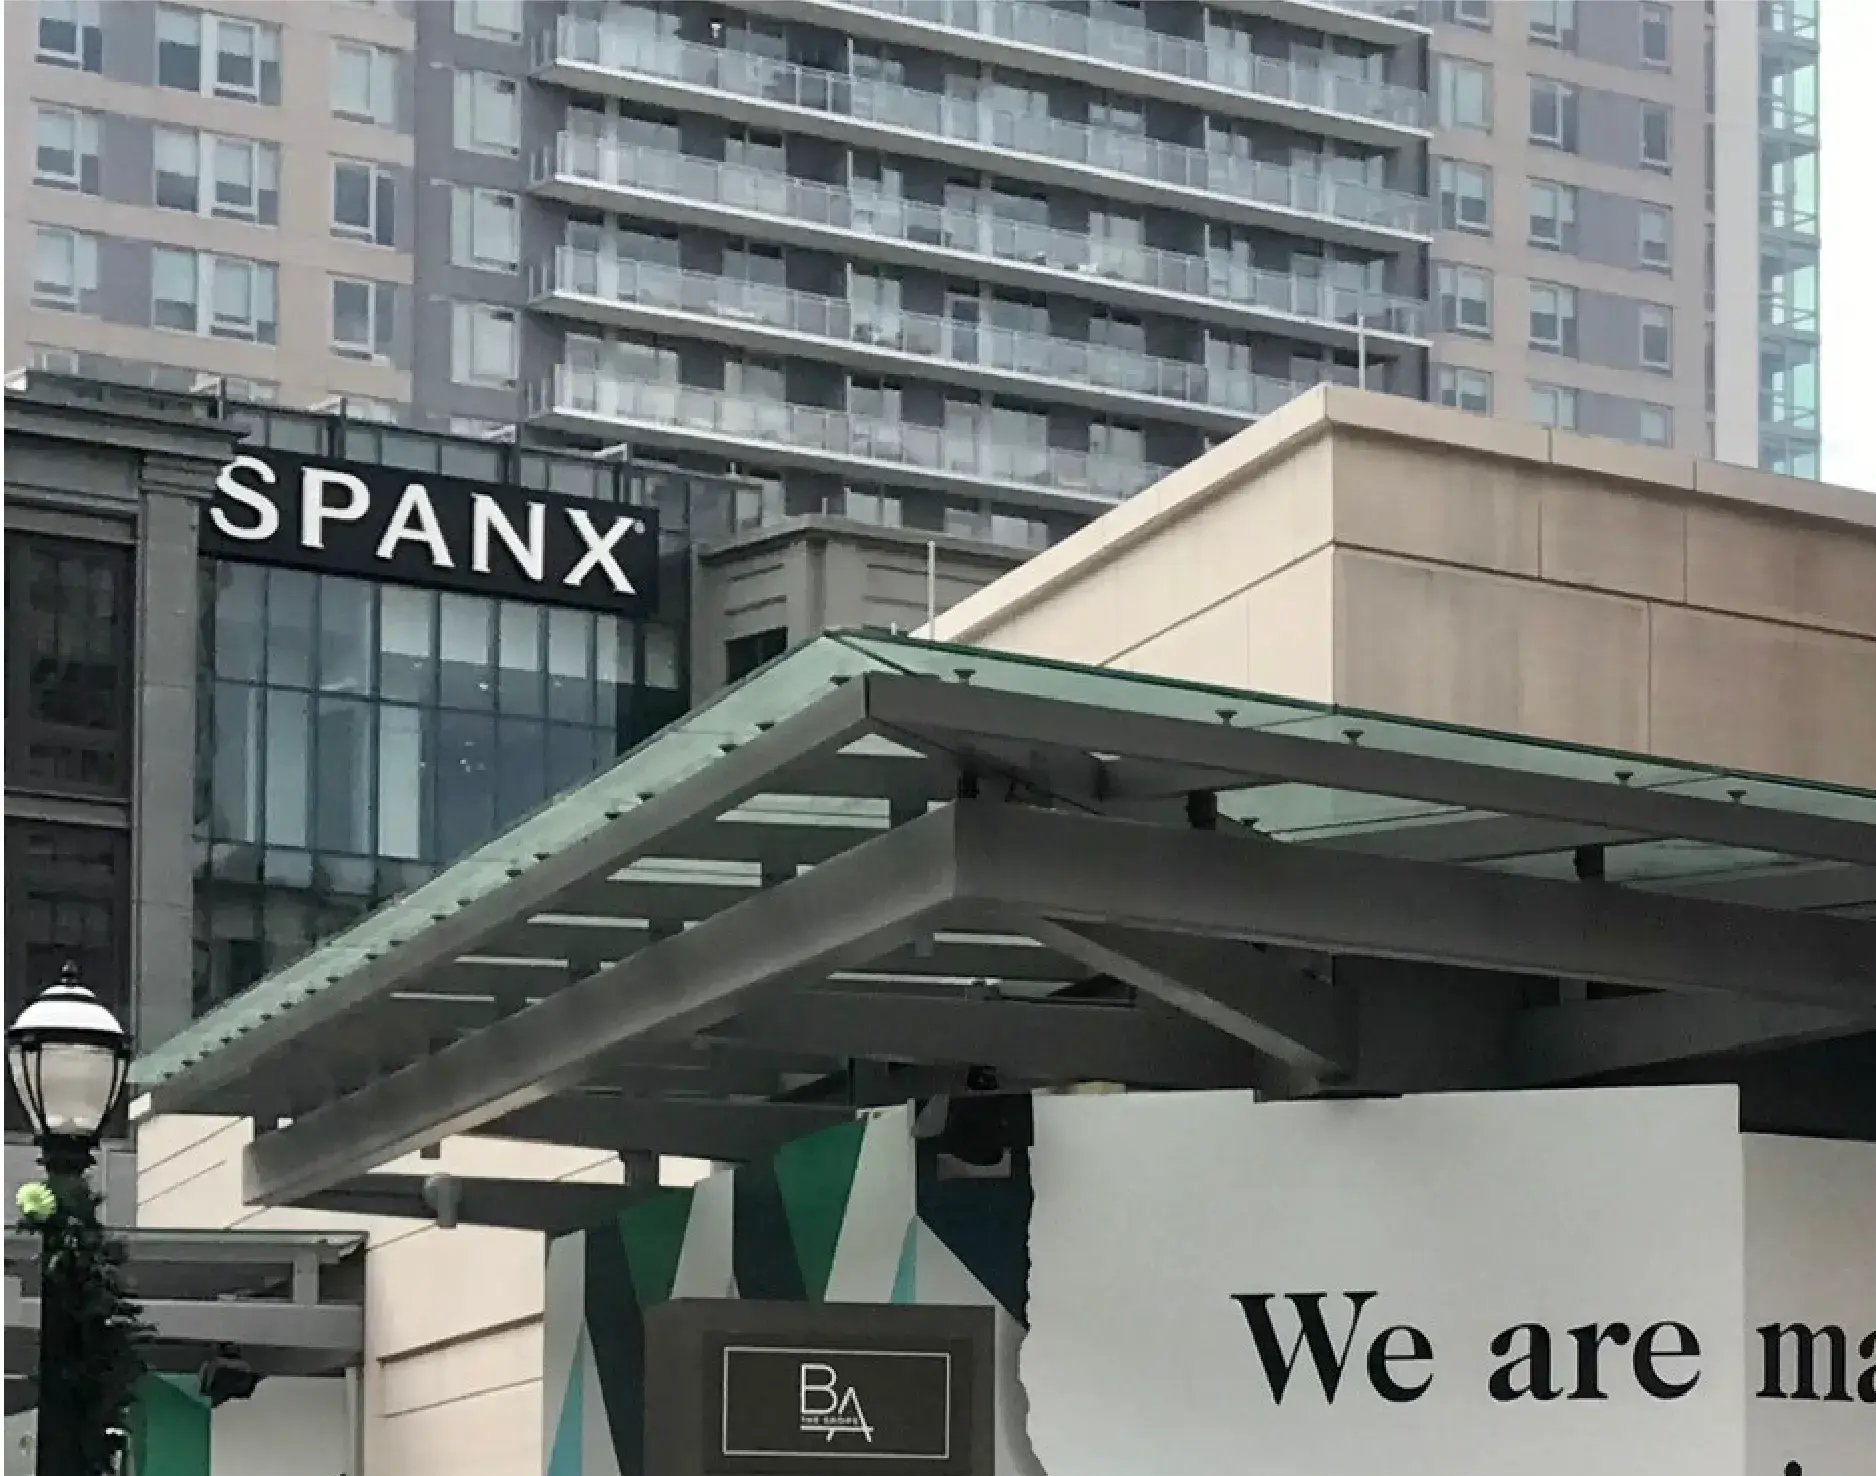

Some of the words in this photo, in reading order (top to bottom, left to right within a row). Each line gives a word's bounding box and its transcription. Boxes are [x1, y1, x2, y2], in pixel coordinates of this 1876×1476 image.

[210, 455, 637, 595] SPANX
[1230, 1290, 1434, 1405] We
[1487, 1320, 1702, 1403] are
